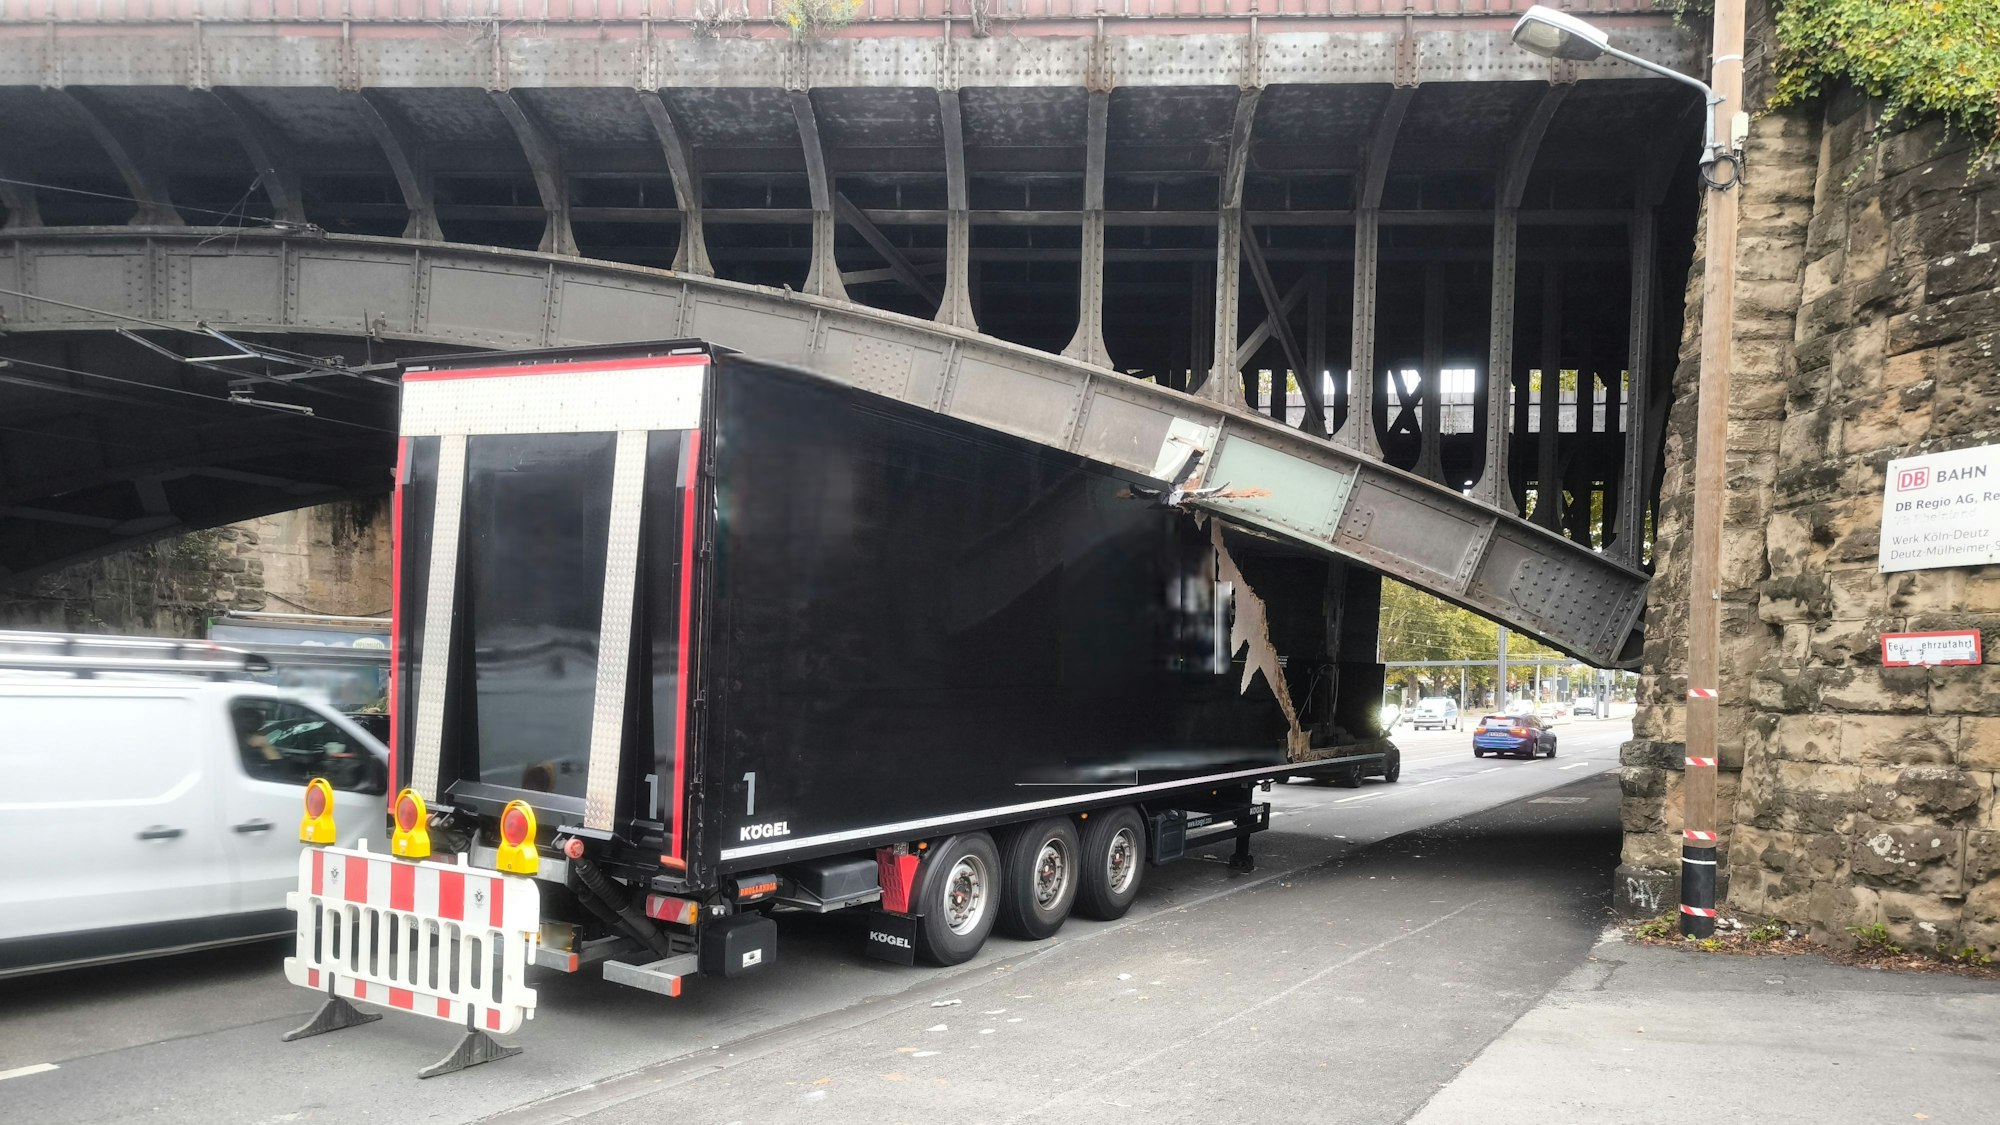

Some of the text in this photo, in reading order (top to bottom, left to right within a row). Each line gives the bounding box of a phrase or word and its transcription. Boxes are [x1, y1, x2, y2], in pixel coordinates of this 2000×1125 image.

[1901, 465, 1987, 488] DB BAHN
[1895, 501, 1912, 512] DB
[1916, 497, 1951, 510] Regio
[1955, 493, 1978, 505] AG,
[1892, 529, 1990, 546] Werk Köln-Deutz
[644, 773, 659, 820] 1
[742, 772, 756, 816] 1
[740, 821, 790, 841] KÖGEL
[869, 930, 911, 949] KÖGEL
